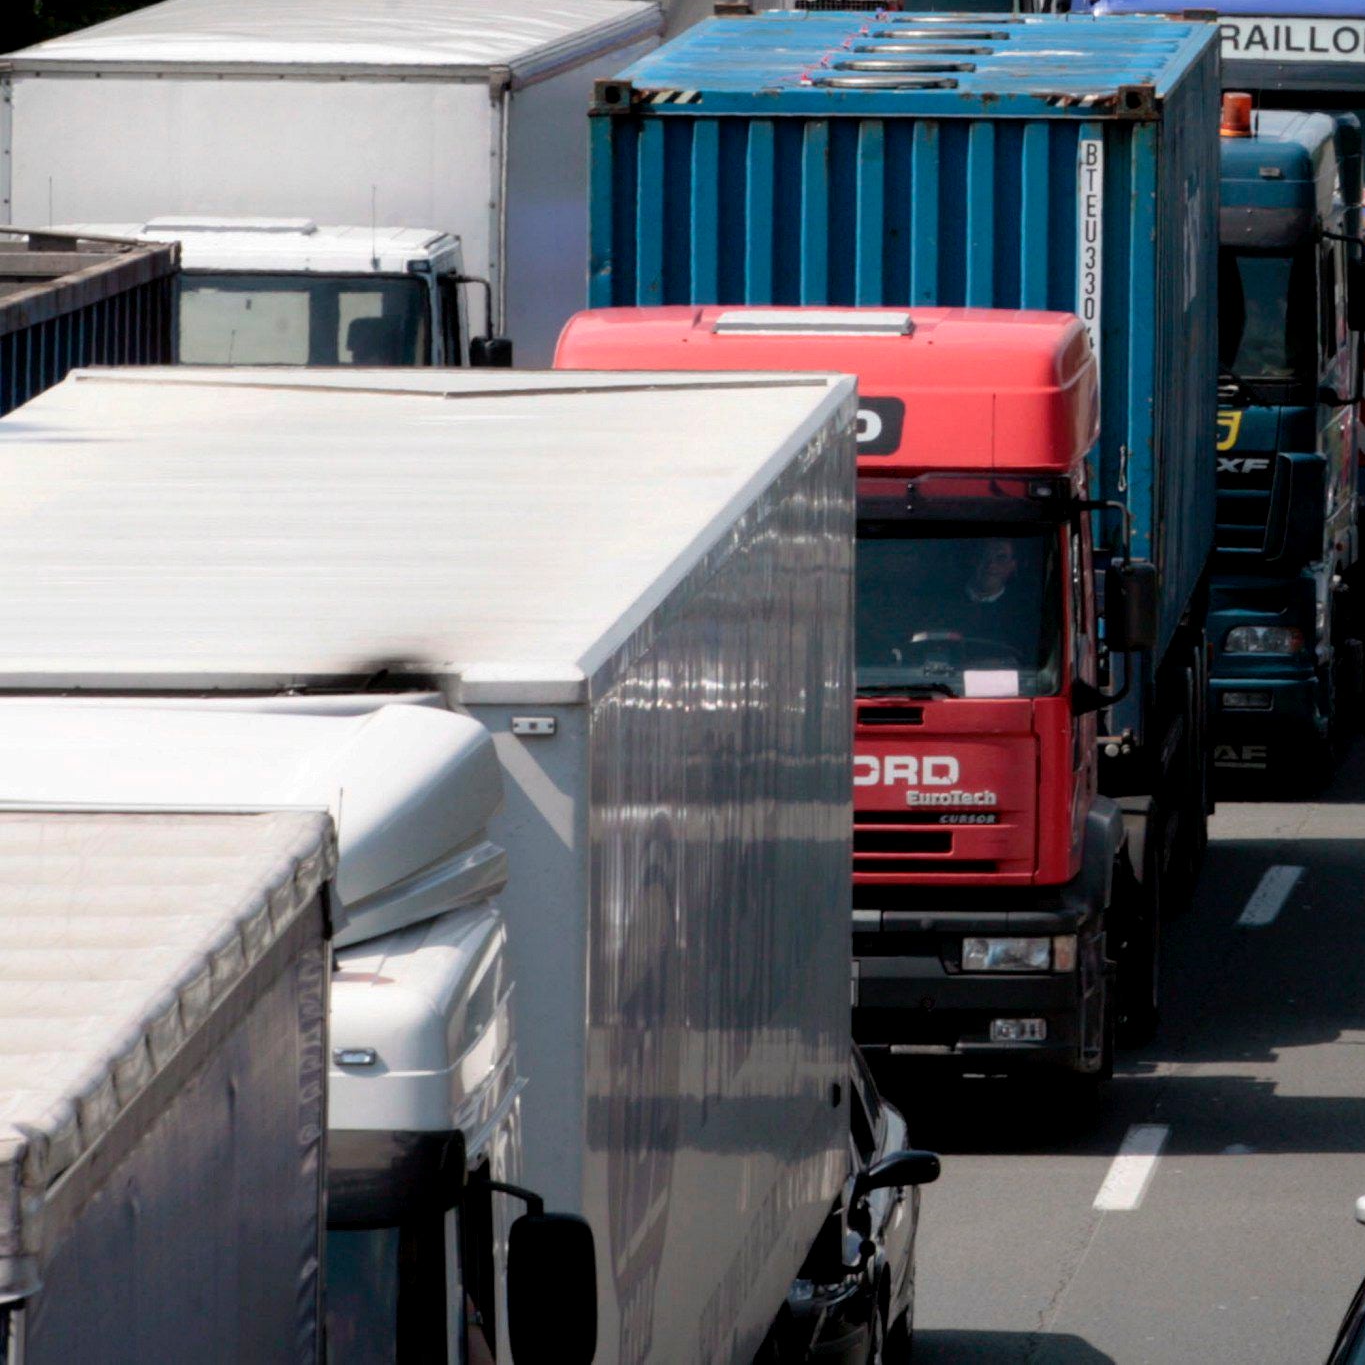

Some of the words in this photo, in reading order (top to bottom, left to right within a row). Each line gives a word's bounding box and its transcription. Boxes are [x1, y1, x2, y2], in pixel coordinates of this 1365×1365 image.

[1216, 457, 1270, 473] XF
[905, 789, 997, 806] EuroTech
[939, 814, 997, 824] CURSOR
